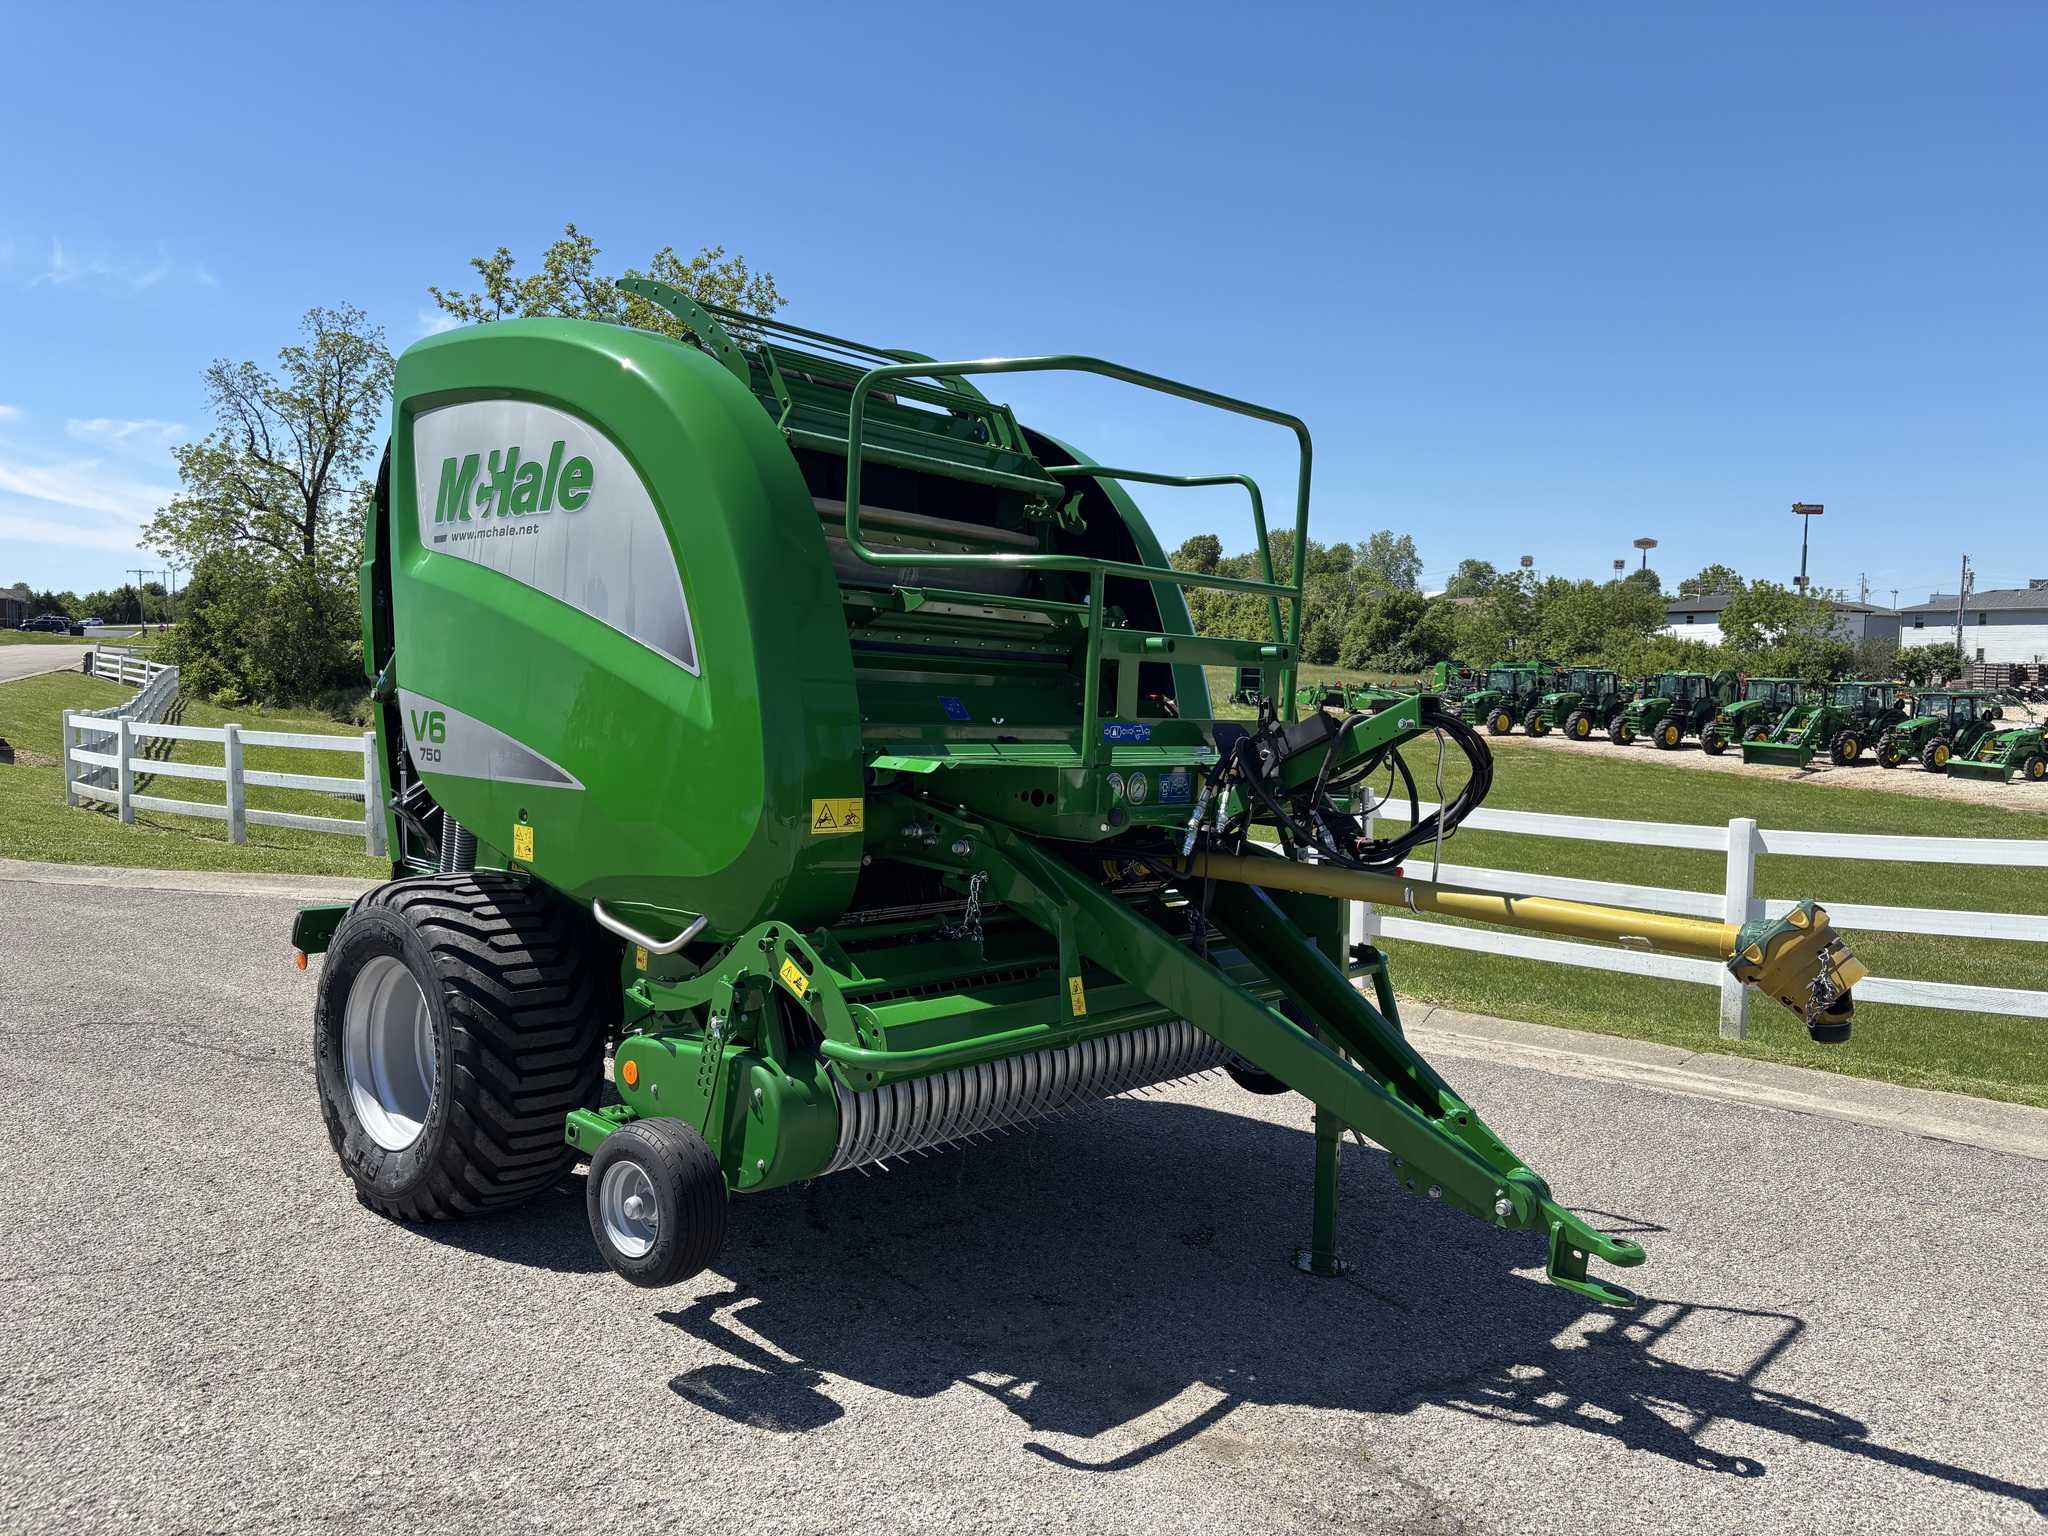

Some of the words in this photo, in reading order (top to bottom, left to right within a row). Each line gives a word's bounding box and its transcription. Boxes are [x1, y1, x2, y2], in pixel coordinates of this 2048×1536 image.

[434, 440, 595, 524] McHale
[451, 523, 539, 542] www.mchale.net
[410, 709, 446, 744] V6
[419, 748, 442, 763] 750
